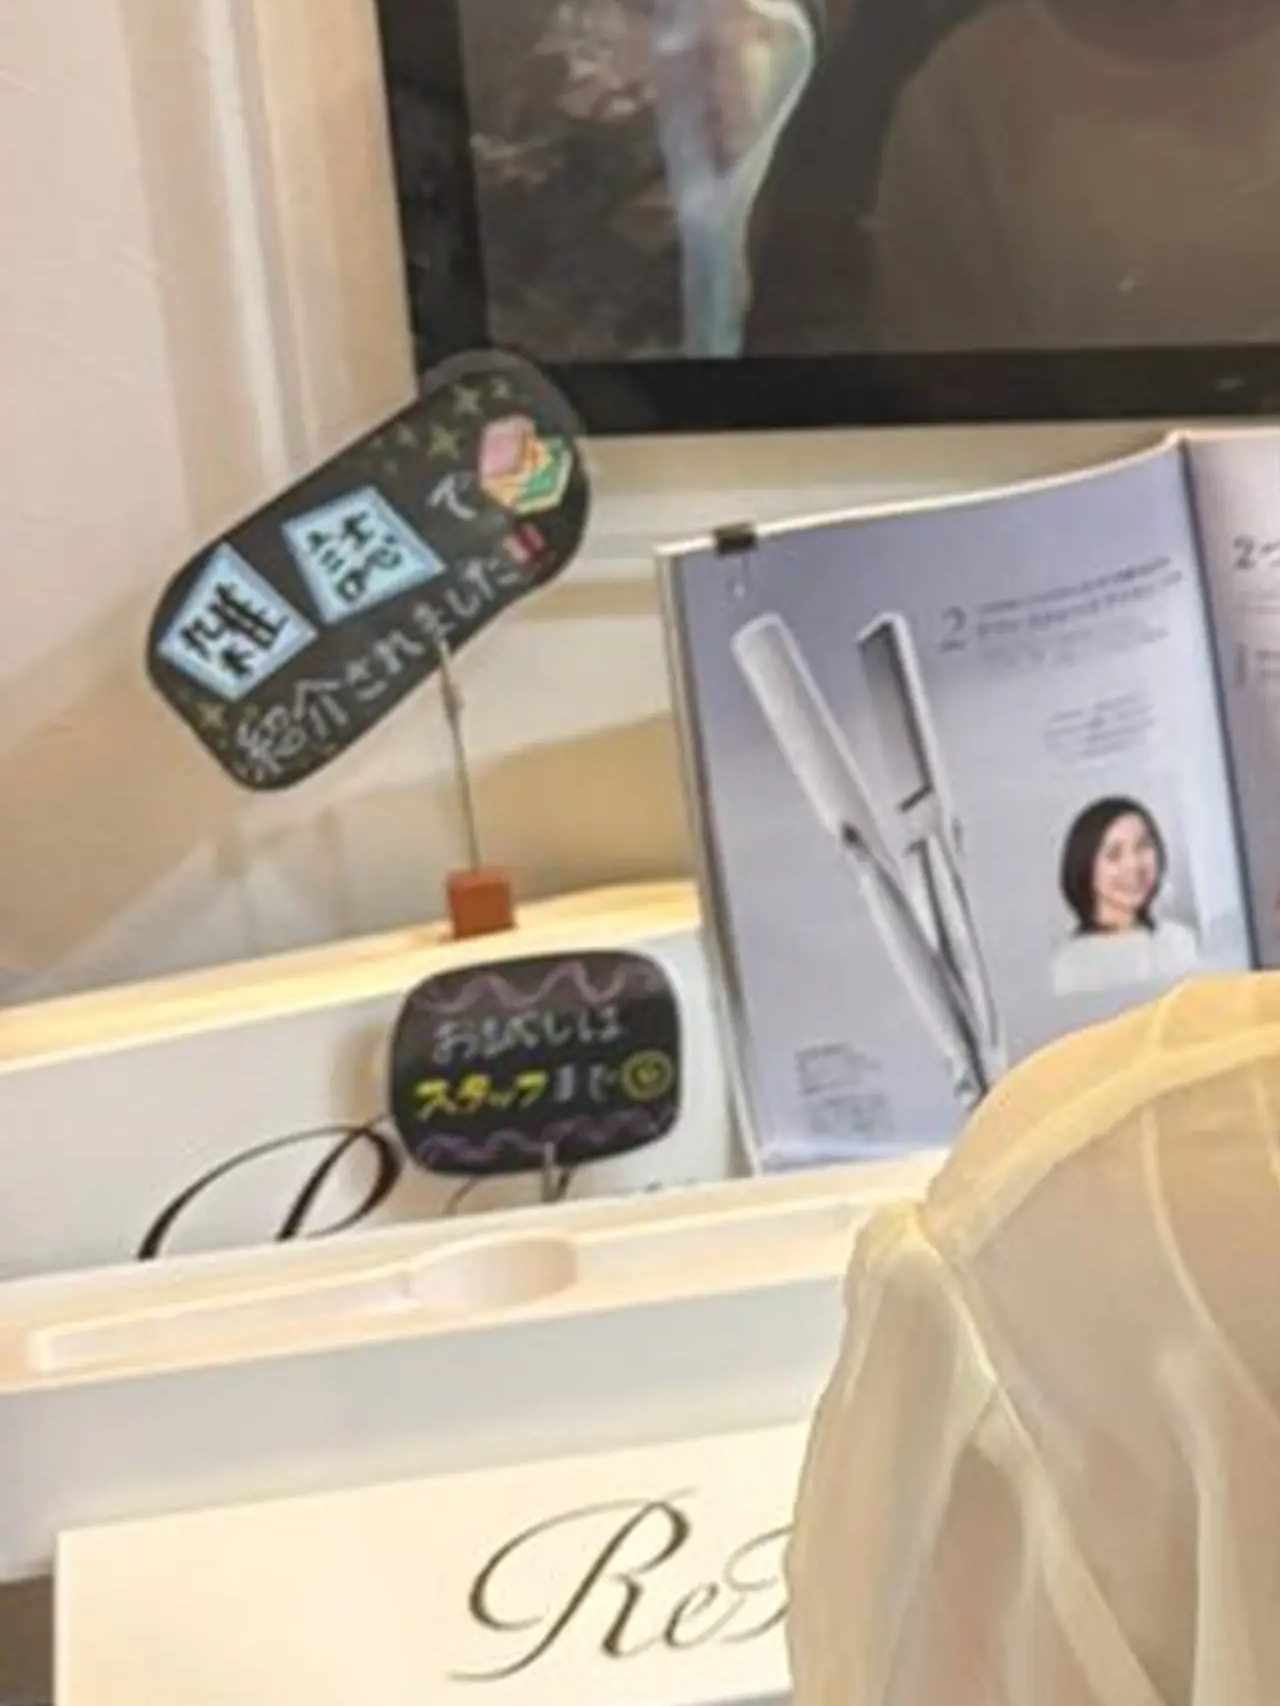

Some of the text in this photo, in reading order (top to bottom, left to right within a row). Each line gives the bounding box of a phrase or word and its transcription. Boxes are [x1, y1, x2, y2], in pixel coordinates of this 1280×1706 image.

[178, 474, 479, 679] 雑誌で
[232, 555, 520, 783] 紹介されました
